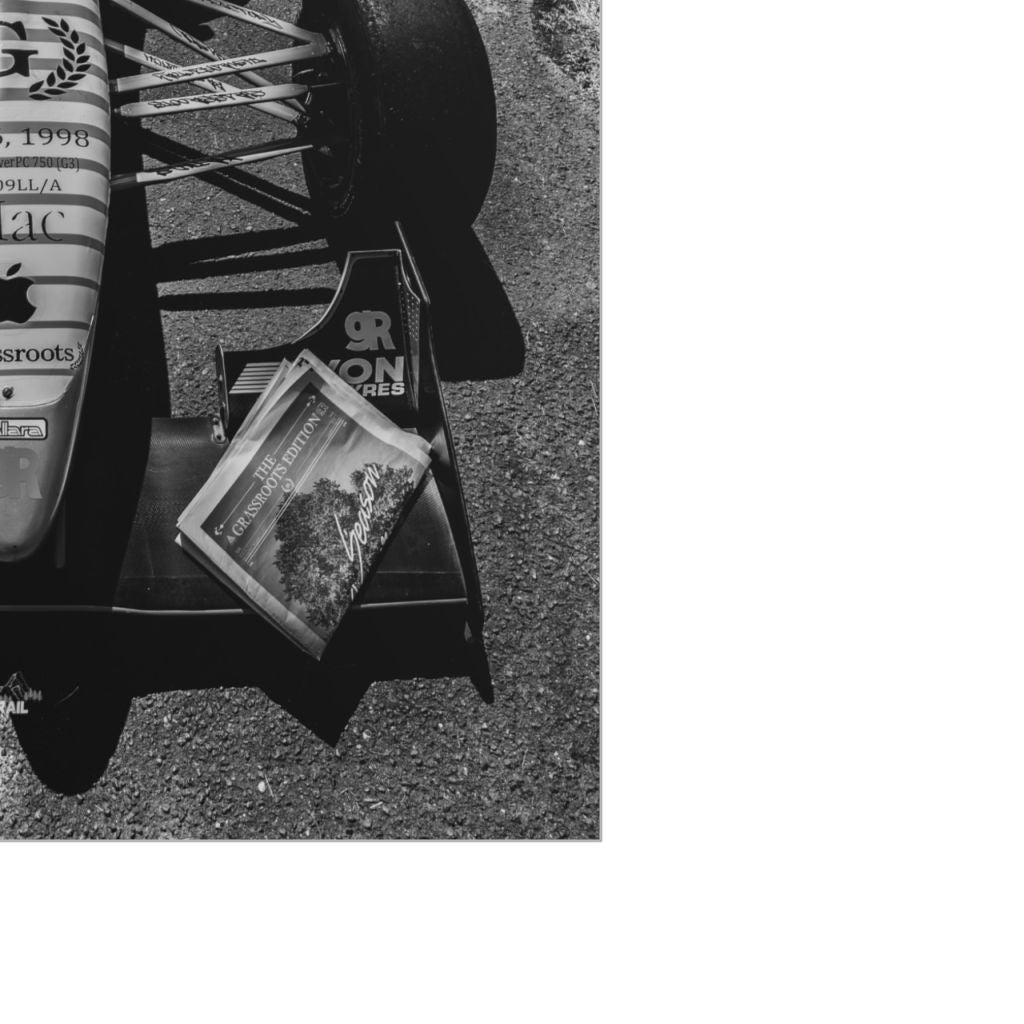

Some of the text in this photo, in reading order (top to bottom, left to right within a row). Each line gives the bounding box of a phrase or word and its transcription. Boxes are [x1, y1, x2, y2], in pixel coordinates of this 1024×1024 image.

[22, 127, 90, 148] 1998
[33, 156, 53, 168] 750
[56, 157, 80, 172] (G3)
[328, 356, 405, 385] ON
[230, 412, 322, 537] GRASSROOTS EDITION
[252, 453, 278, 482] THE
